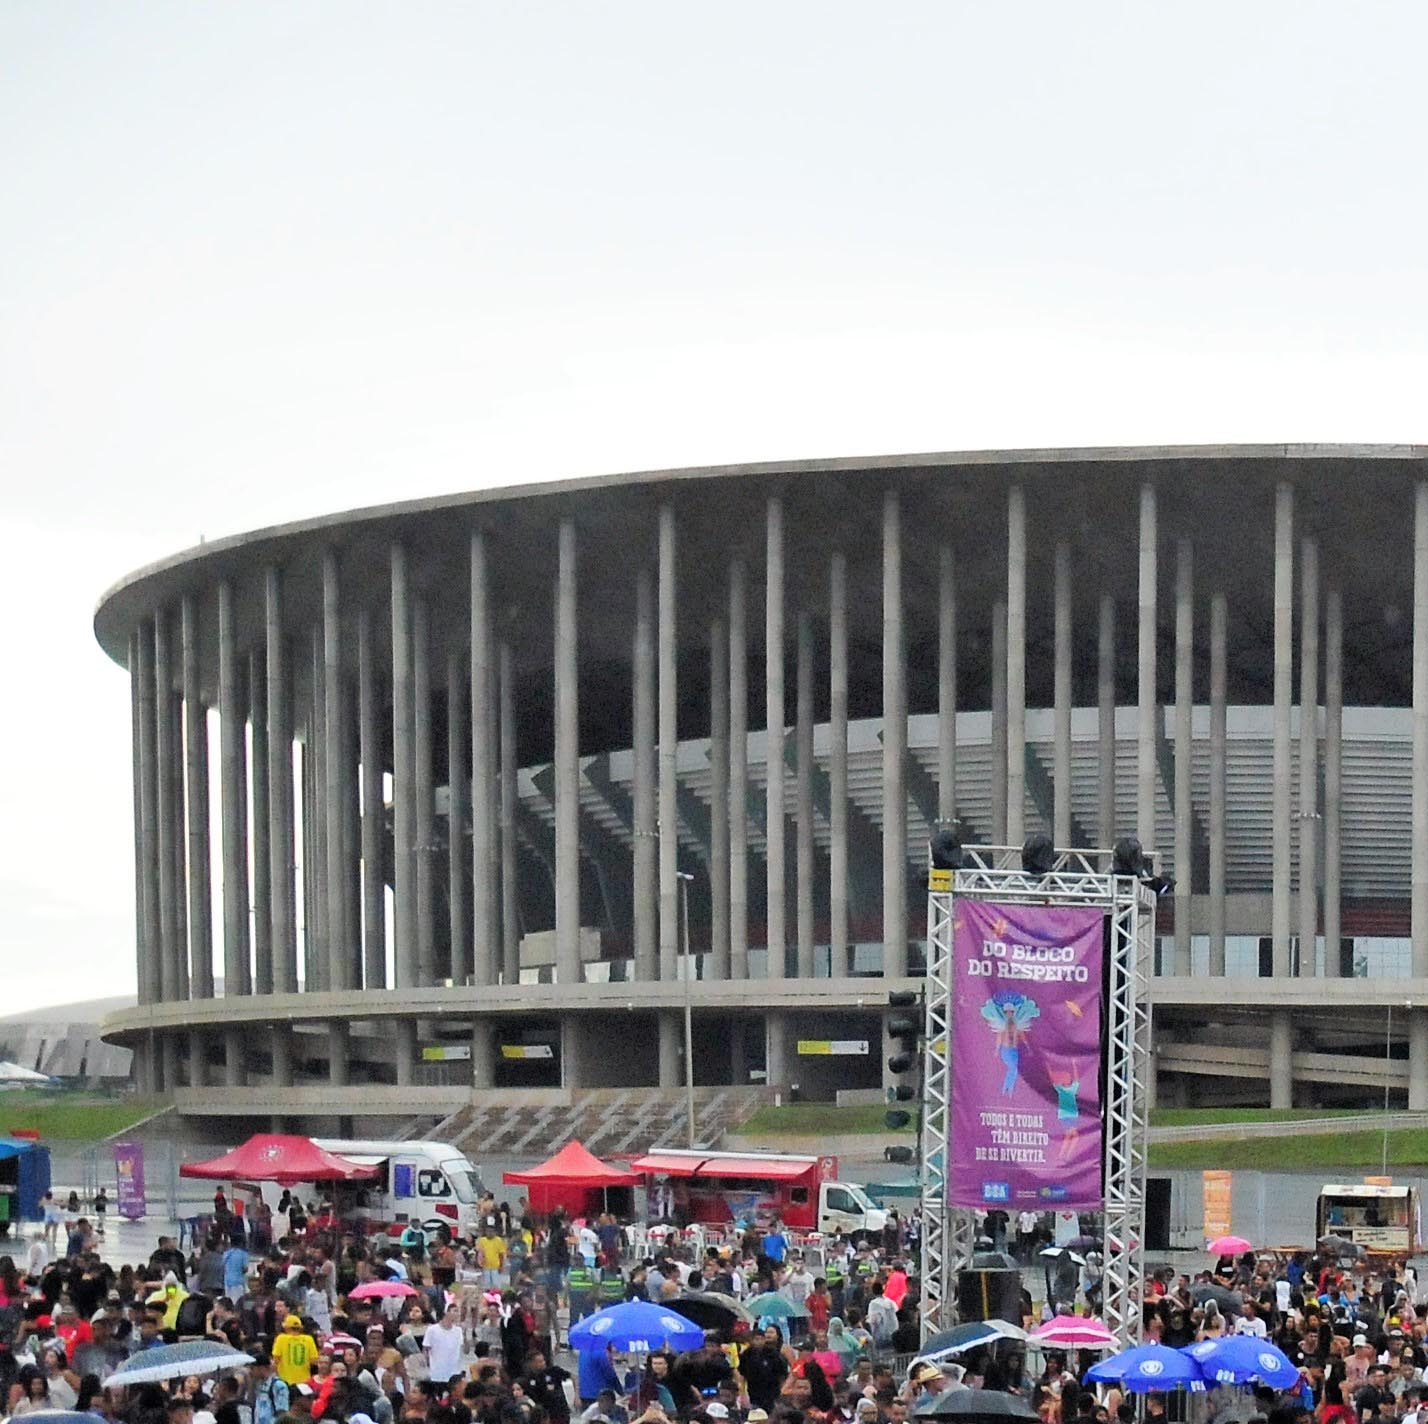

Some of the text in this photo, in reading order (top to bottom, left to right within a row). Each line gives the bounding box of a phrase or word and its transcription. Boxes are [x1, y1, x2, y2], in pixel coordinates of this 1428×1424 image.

[983, 941, 1075, 963] DO BLOCO
[968, 960, 1089, 983] DO RESPEITO
[980, 1112, 1009, 1128] TODOS
[1016, 1114, 1043, 1128] TODAS
[1013, 1131, 1049, 1146] DIREITO
[975, 1147, 986, 1161] DE
[987, 1148, 999, 1162] SE
